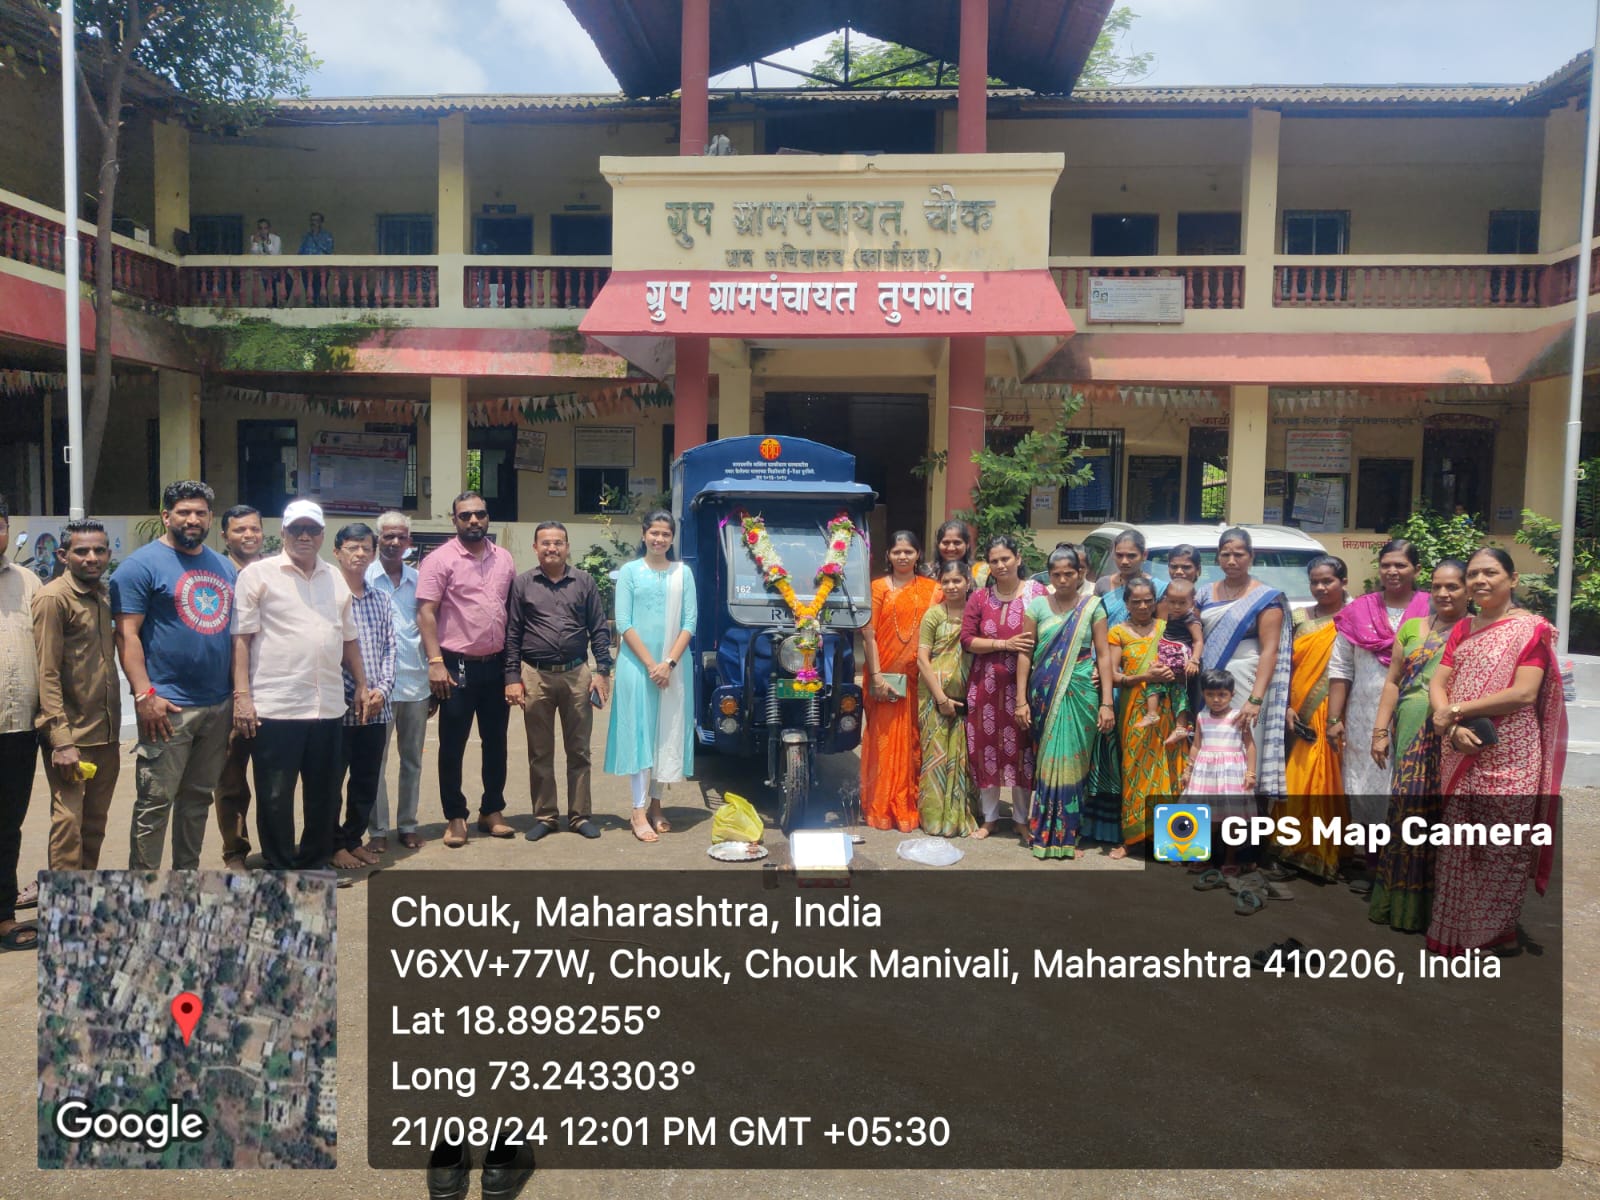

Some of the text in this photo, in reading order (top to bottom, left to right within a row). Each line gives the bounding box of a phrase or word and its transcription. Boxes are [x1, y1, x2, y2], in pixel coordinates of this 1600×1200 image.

[665, 202, 714, 249] ग्रुप
[923, 184, 997, 236] चौक
[646, 273, 975, 324] ग्रुप ग्रामपंचायत तुपगांव
[735, 585, 751, 594] 162
